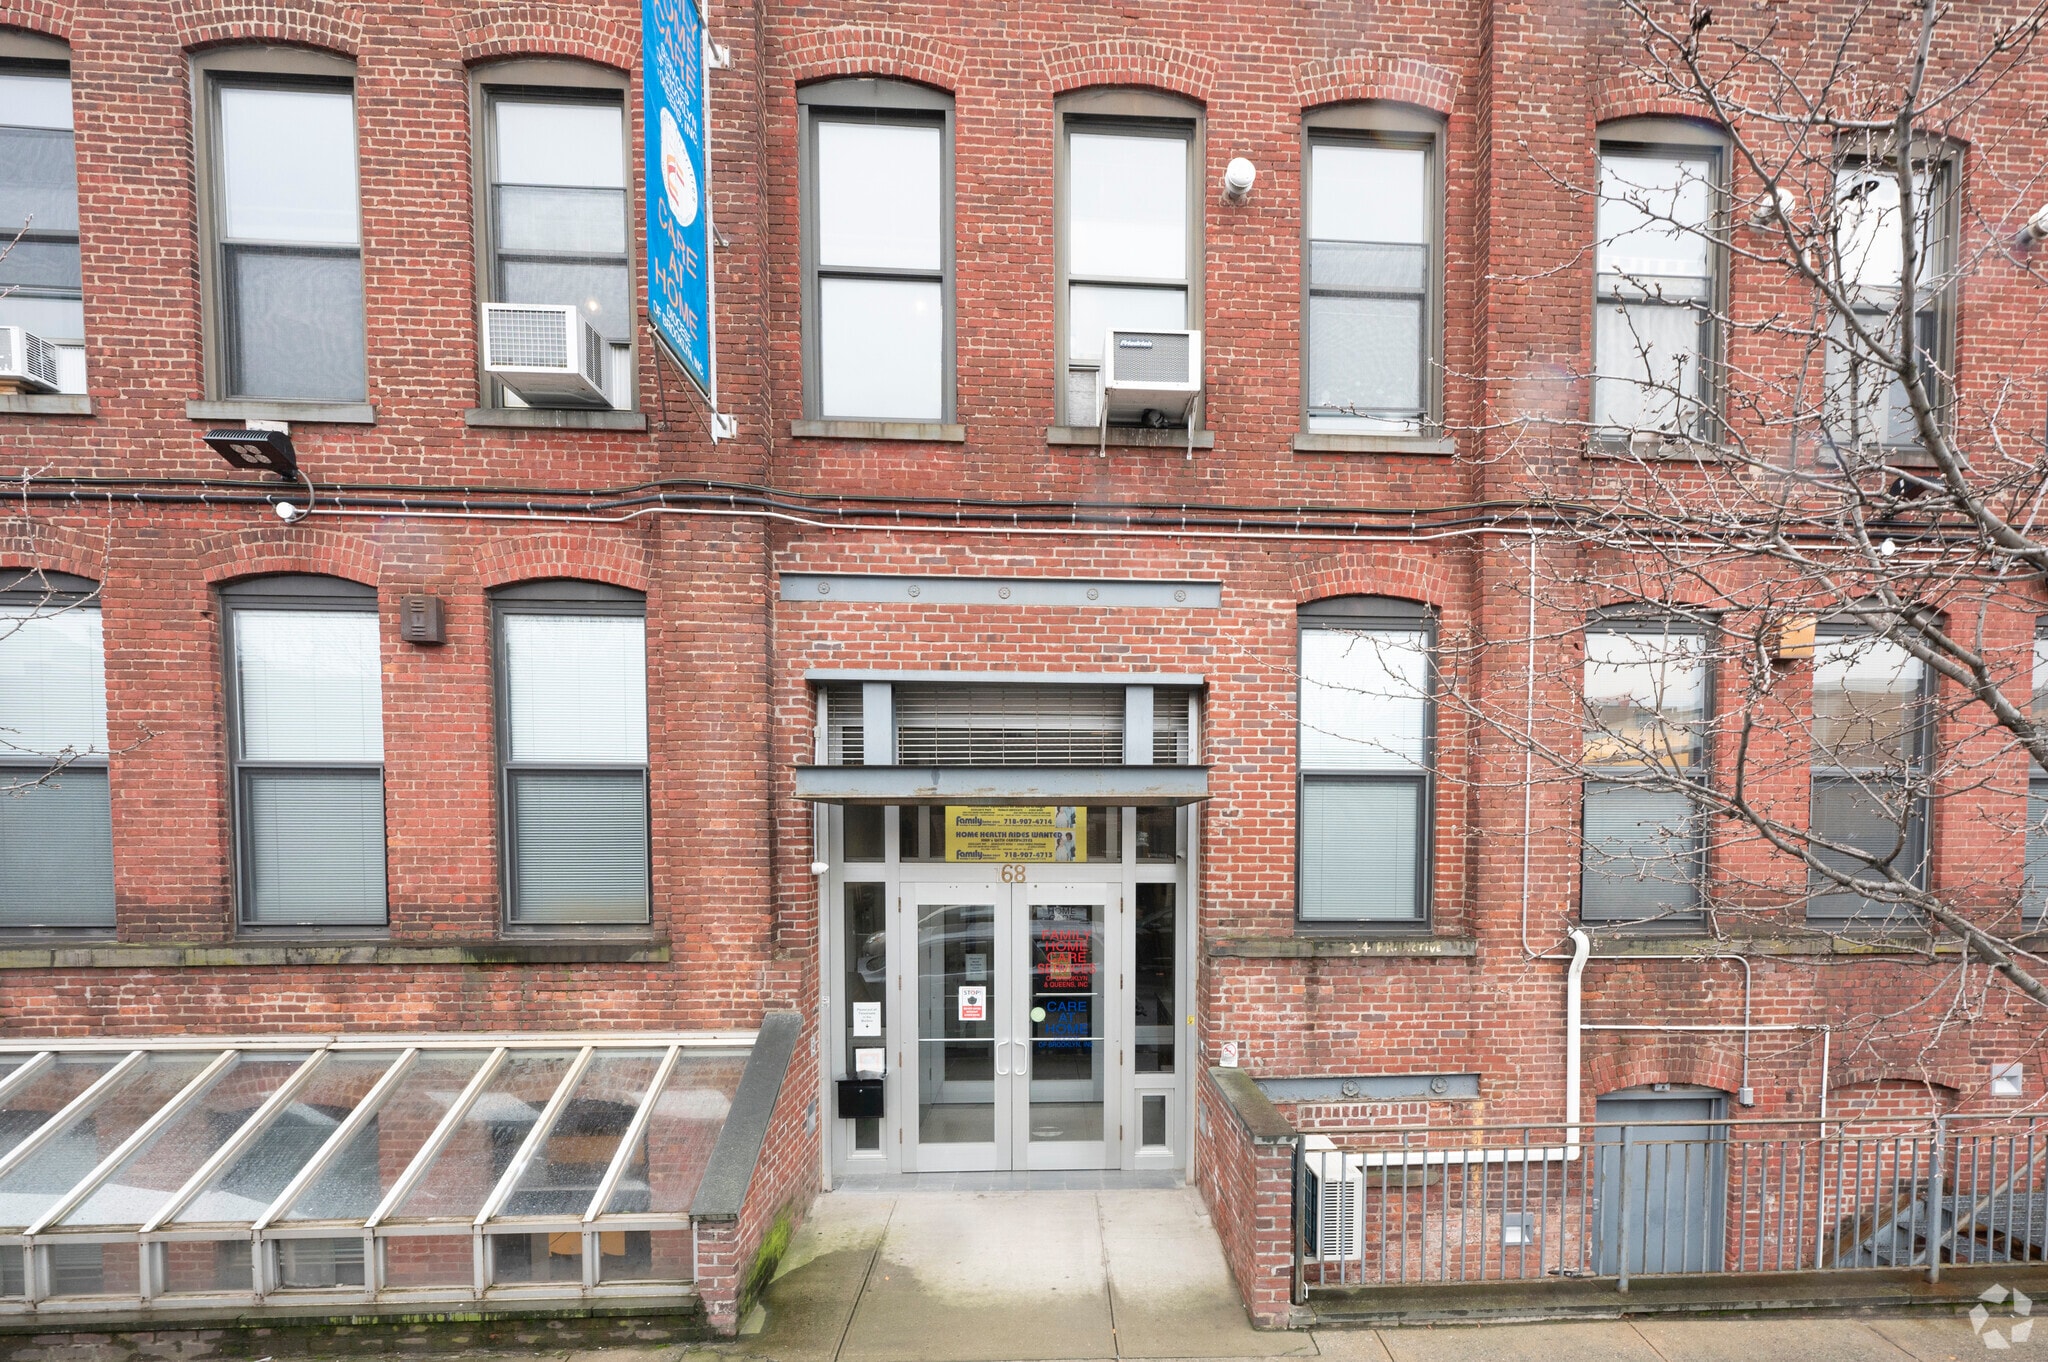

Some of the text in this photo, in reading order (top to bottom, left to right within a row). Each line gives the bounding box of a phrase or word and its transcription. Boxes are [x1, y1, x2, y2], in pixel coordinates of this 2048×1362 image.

[663, 0, 697, 72] OME
[654, 0, 697, 100] CARE
[658, 197, 698, 279] CARE
[669, 250, 684, 289] AT
[655, 256, 698, 341] HOME
[653, 299, 662, 318] OF
[1031, 831, 1063, 839] WANTED
[1001, 864, 1026, 884] 68
[1041, 929, 1093, 941] FAMILY
[1045, 940, 1088, 952] HOME
[1046, 951, 1087, 963] CARE
[1037, 963, 1096, 974] SERVICES
[1046, 1001, 1087, 1012] CARE
[1058, 1012, 1076, 1022] AT
[1045, 1023, 1088, 1034] HOME
